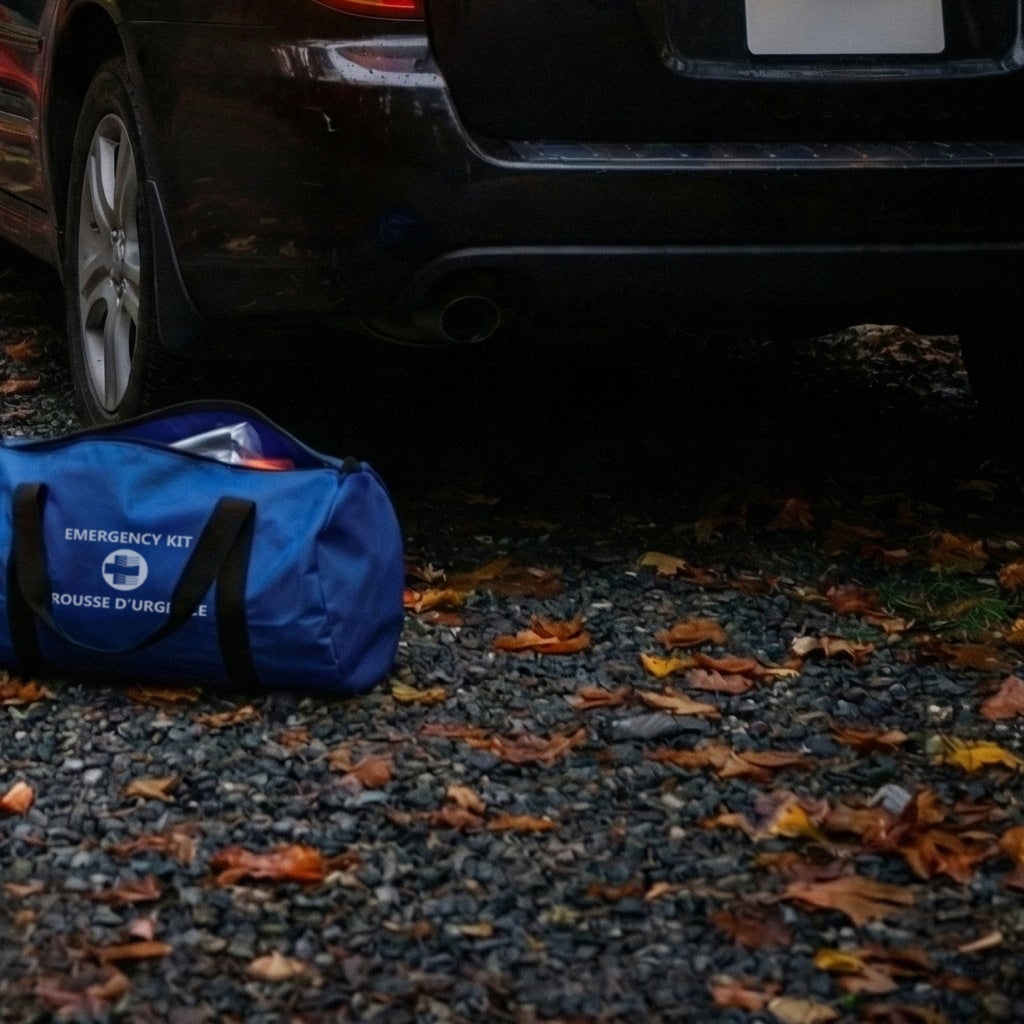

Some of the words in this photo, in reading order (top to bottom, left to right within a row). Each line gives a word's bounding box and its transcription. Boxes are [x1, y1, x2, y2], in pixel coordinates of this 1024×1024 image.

[65, 528, 162, 546] EMERGENCY
[166, 535, 194, 548] KIT
[51, 592, 111, 609] ROUSSE
[115, 597, 208, 617] D'URGE
